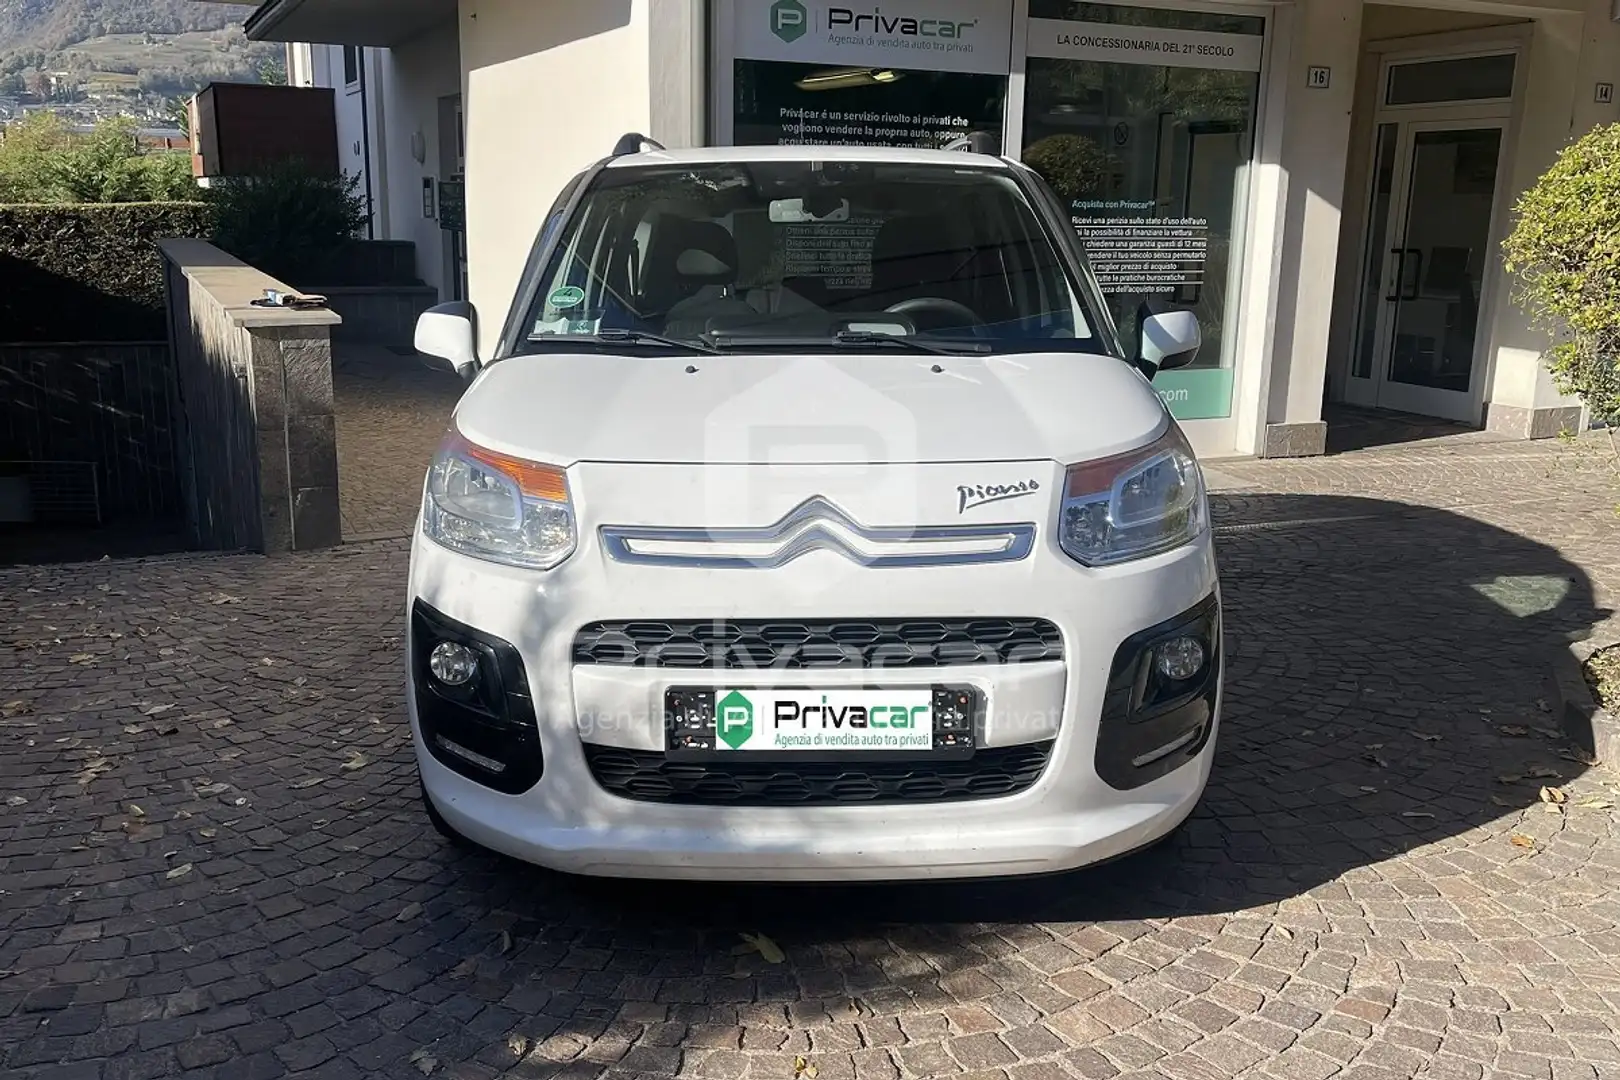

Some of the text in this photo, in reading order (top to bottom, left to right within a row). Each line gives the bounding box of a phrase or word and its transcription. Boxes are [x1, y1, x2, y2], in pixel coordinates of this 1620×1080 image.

[828, 7, 974, 39] Privacar
[828, 33, 974, 53] Agenzia di vendita auto tra privati
[1057, 34, 1070, 45] LA
[1073, 35, 1161, 52] CONCESSIONARIA
[1163, 42, 1180, 53] DEL
[1197, 45, 1234, 57] SECOLO
[1314, 70, 1325, 84] 16
[1600, 86, 1608, 99] 14
[780, 108, 820, 119] Privacar
[829, 112, 841, 120] un
[844, 111, 880, 122] servizio
[882, 112, 911, 123] rivolto
[912, 114, 921, 124] ai
[922, 115, 950, 126] privati
[952, 116, 968, 126] che
[824, 124, 863, 134] vendere
[864, 125, 873, 135] la
[874, 127, 908, 138] propria
[1072, 200, 1104, 210] Acquista
[1072, 216, 1092, 224] Ricevi
[774, 695, 929, 729] Privacar
[774, 732, 929, 748] Agenzia di vendita auto tra privati
